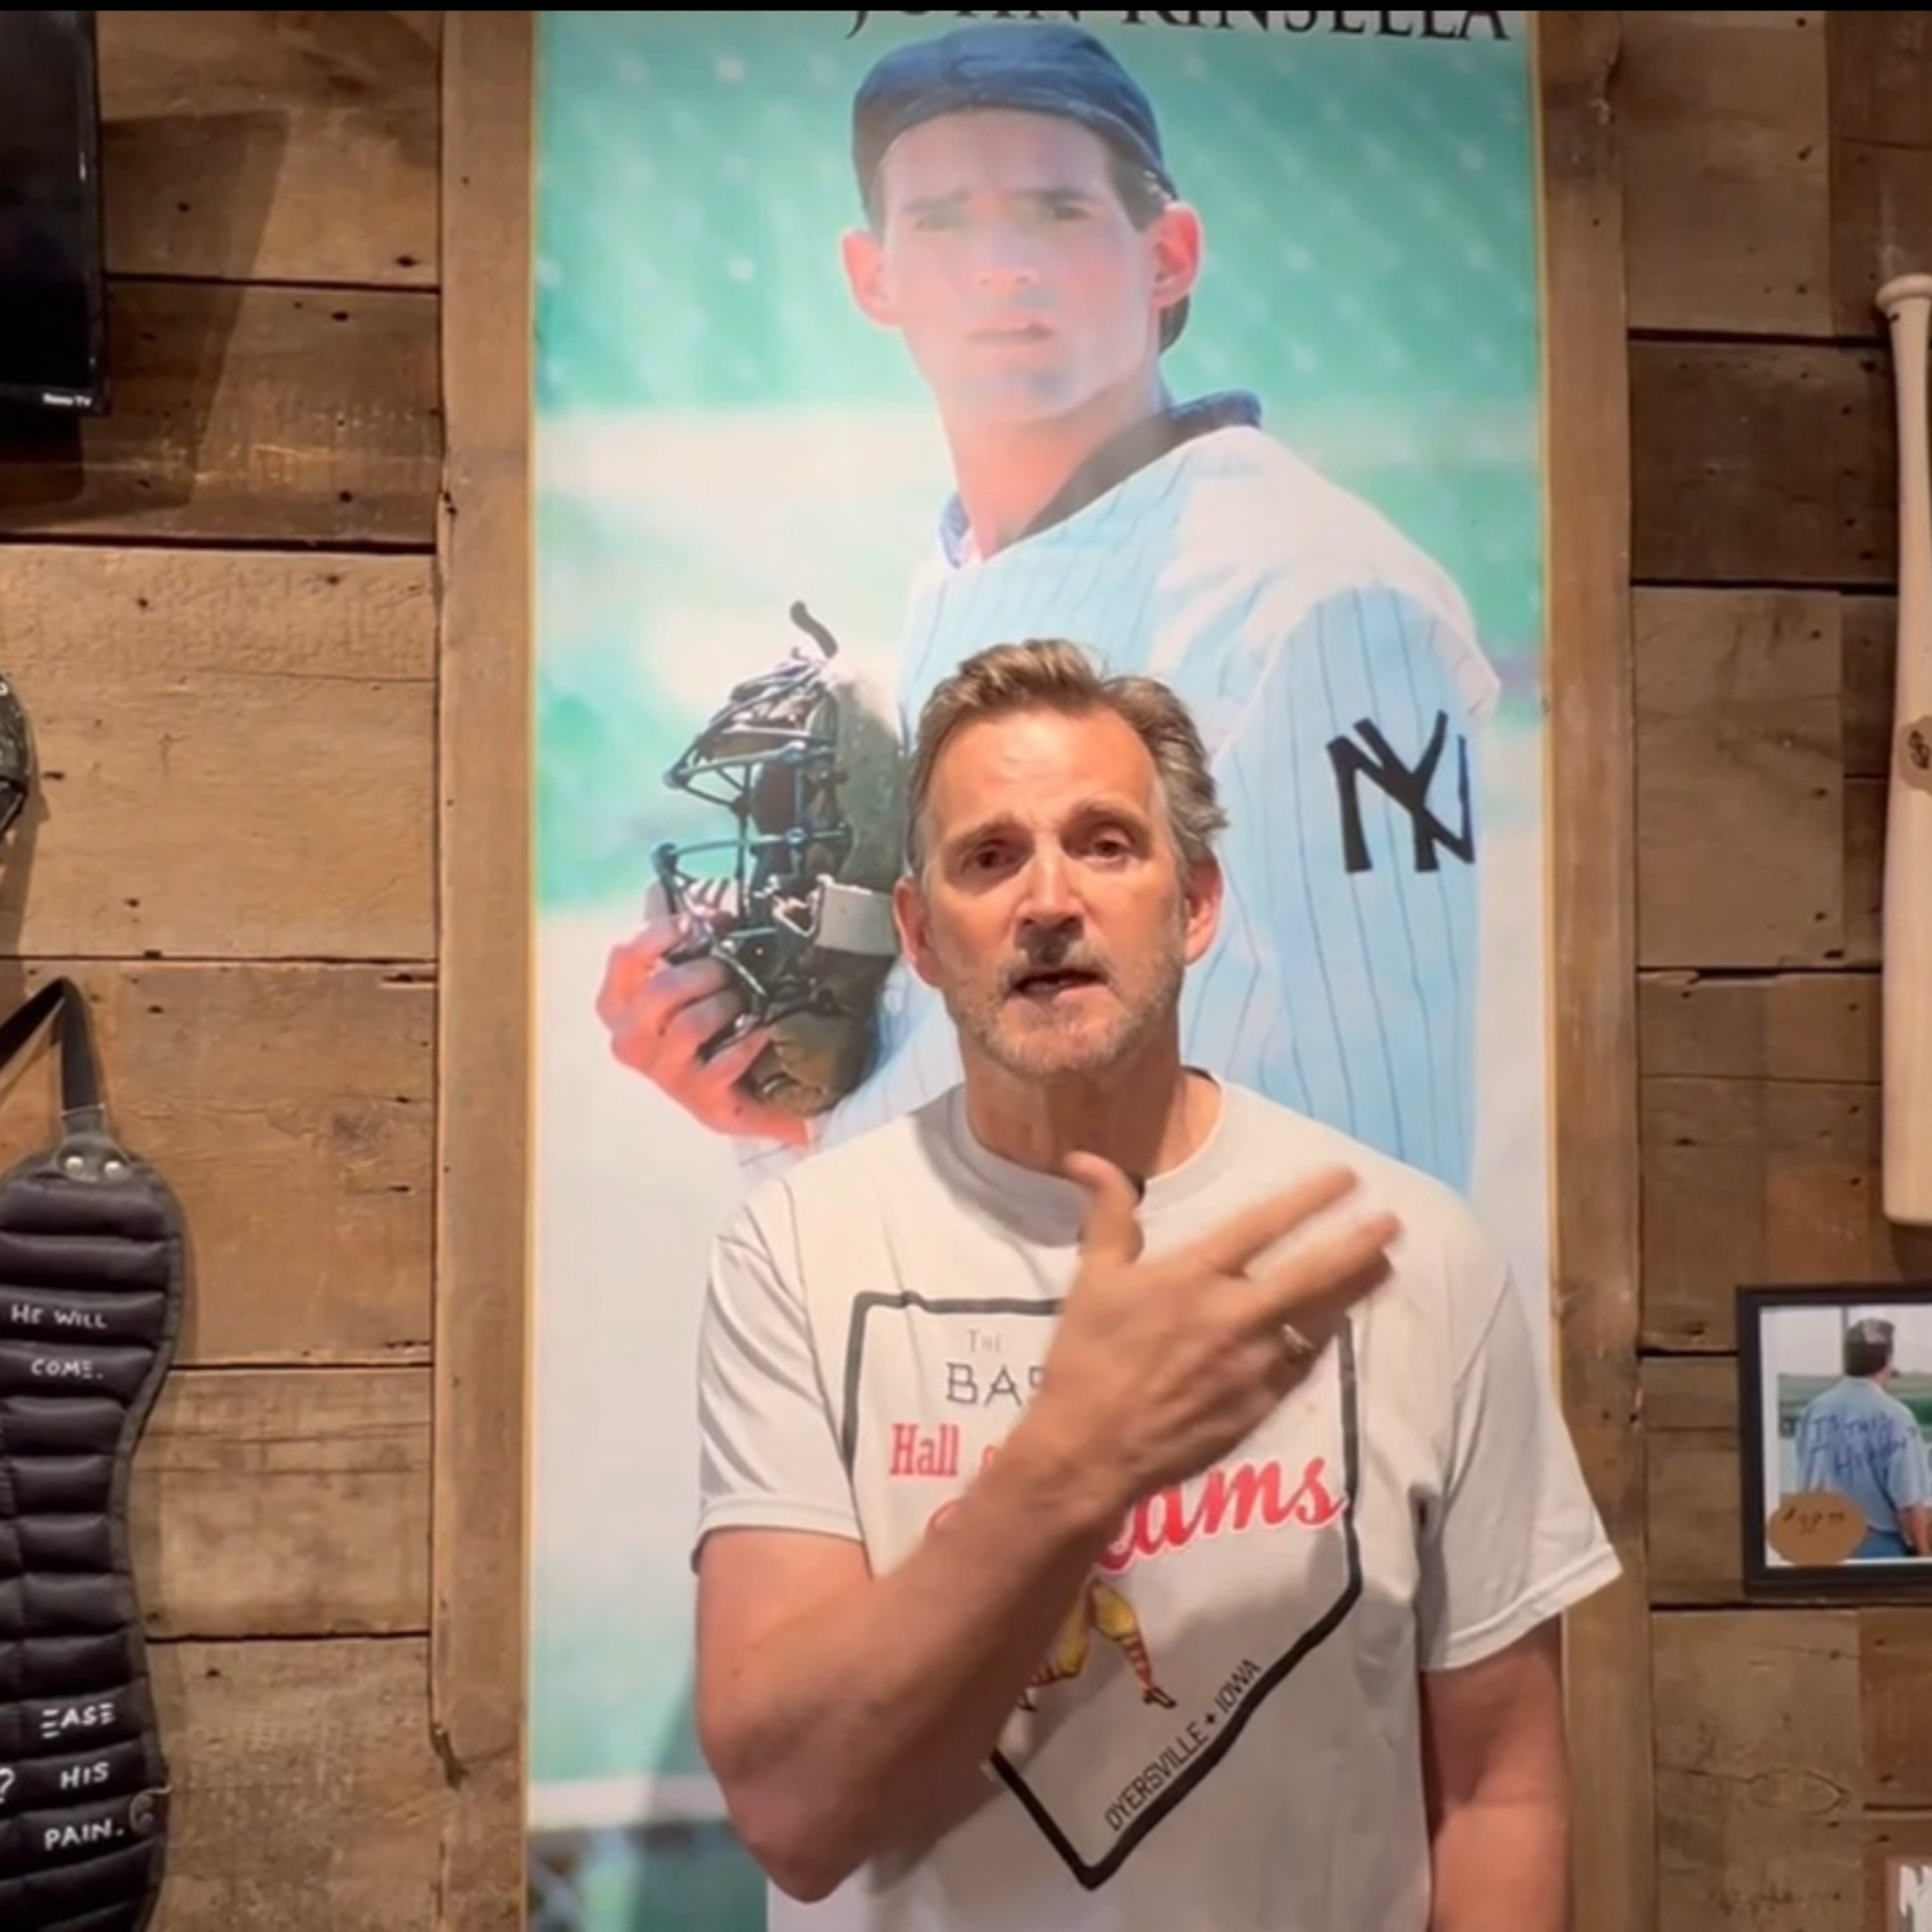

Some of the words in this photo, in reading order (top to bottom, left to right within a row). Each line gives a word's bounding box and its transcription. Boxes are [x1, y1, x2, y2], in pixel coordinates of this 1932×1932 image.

[11, 1303, 43, 1324] HE
[53, 1309, 107, 1329] WILL
[30, 1358, 103, 1379] COME.
[889, 1423, 958, 1477] Hall
[40, 1702, 115, 1738] EASE
[1104, 1721, 1208, 1832] DYERSVILLE
[1214, 1658, 1261, 1714] IOWA
[60, 1761, 109, 1789] HIS
[44, 1818, 124, 1850] PAIN.
